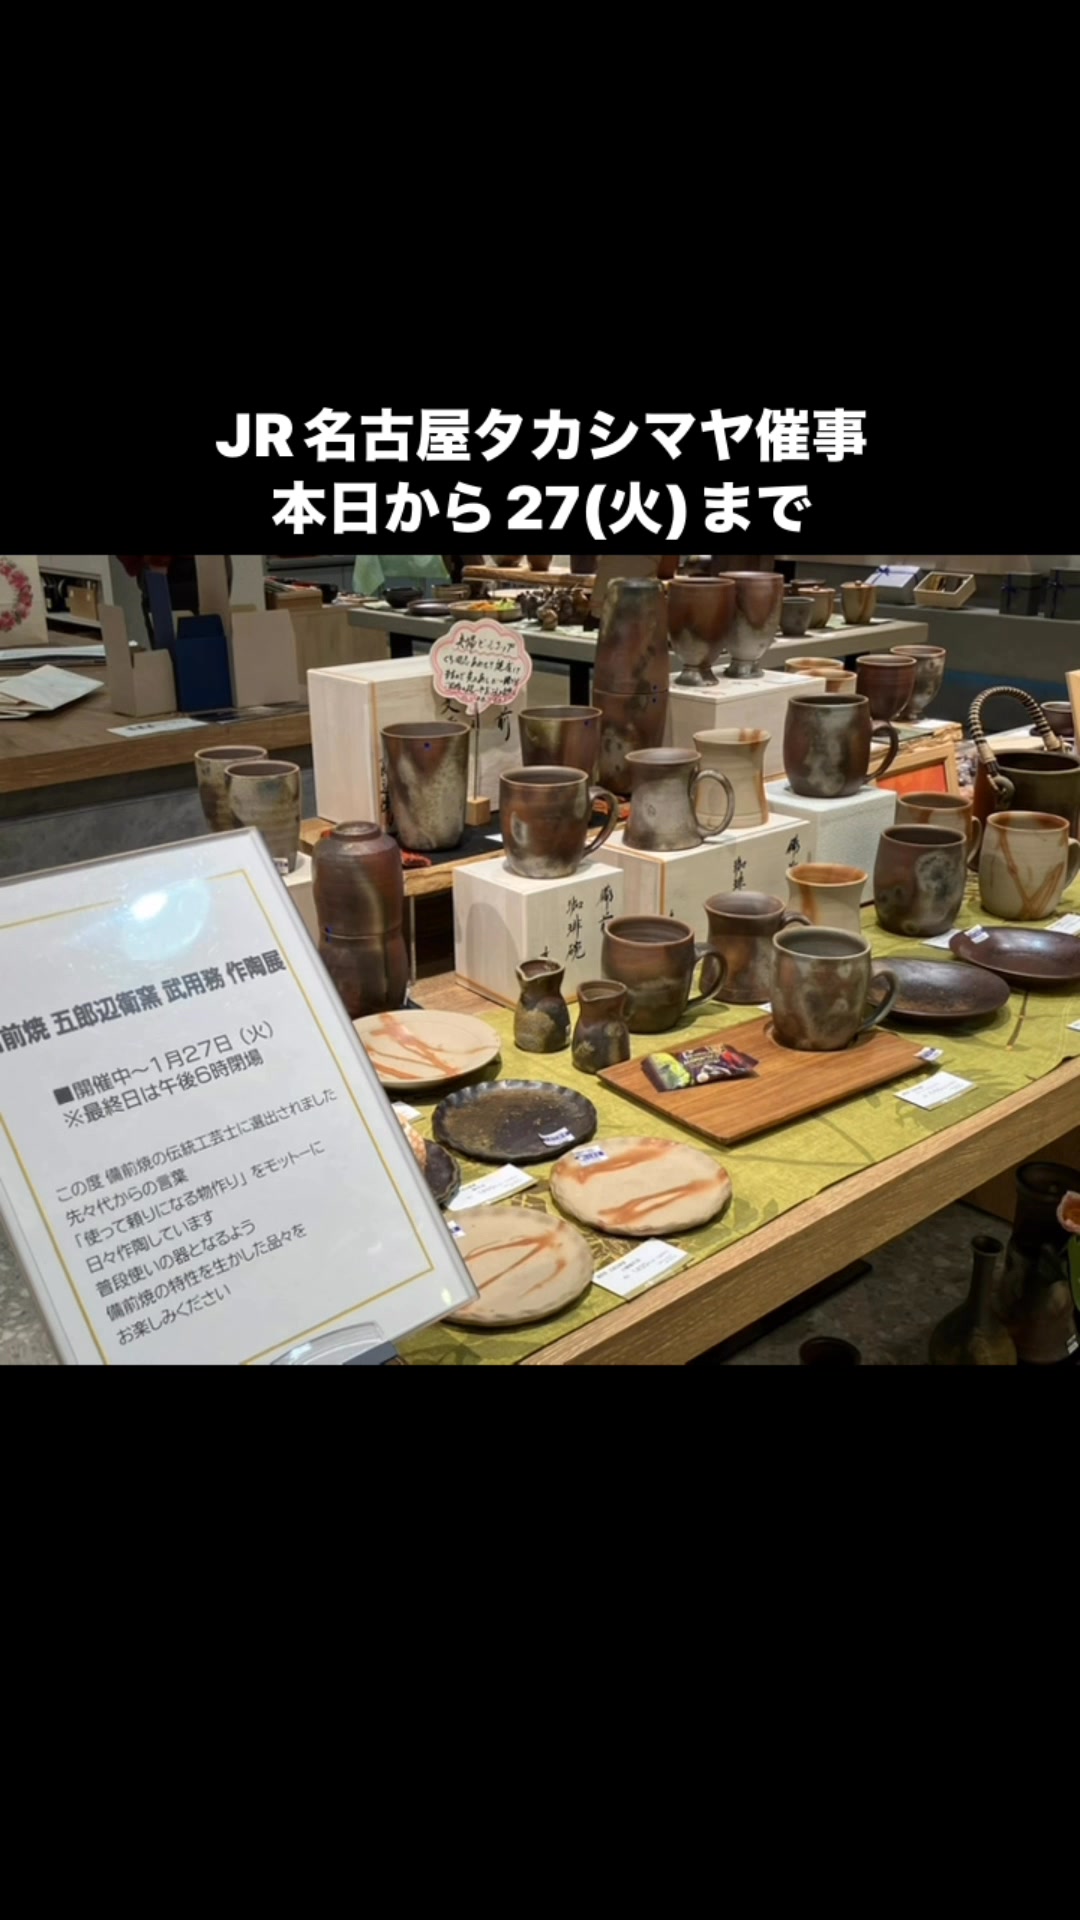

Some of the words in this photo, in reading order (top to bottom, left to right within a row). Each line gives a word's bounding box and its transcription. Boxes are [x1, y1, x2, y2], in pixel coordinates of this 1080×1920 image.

[161, 966, 225, 1003] 武用務
[225, 949, 287, 985] 作陶展
[65, 1167, 190, 1228] 先々代からの言葉
[85, 1209, 214, 1275] 日々作陶しています
[95, 1219, 257, 1299] 普段使いの器となるよう
[105, 1223, 308, 1323] 備前焼の特性を生かした品々を
[116, 1284, 233, 1346] お楽しみください
